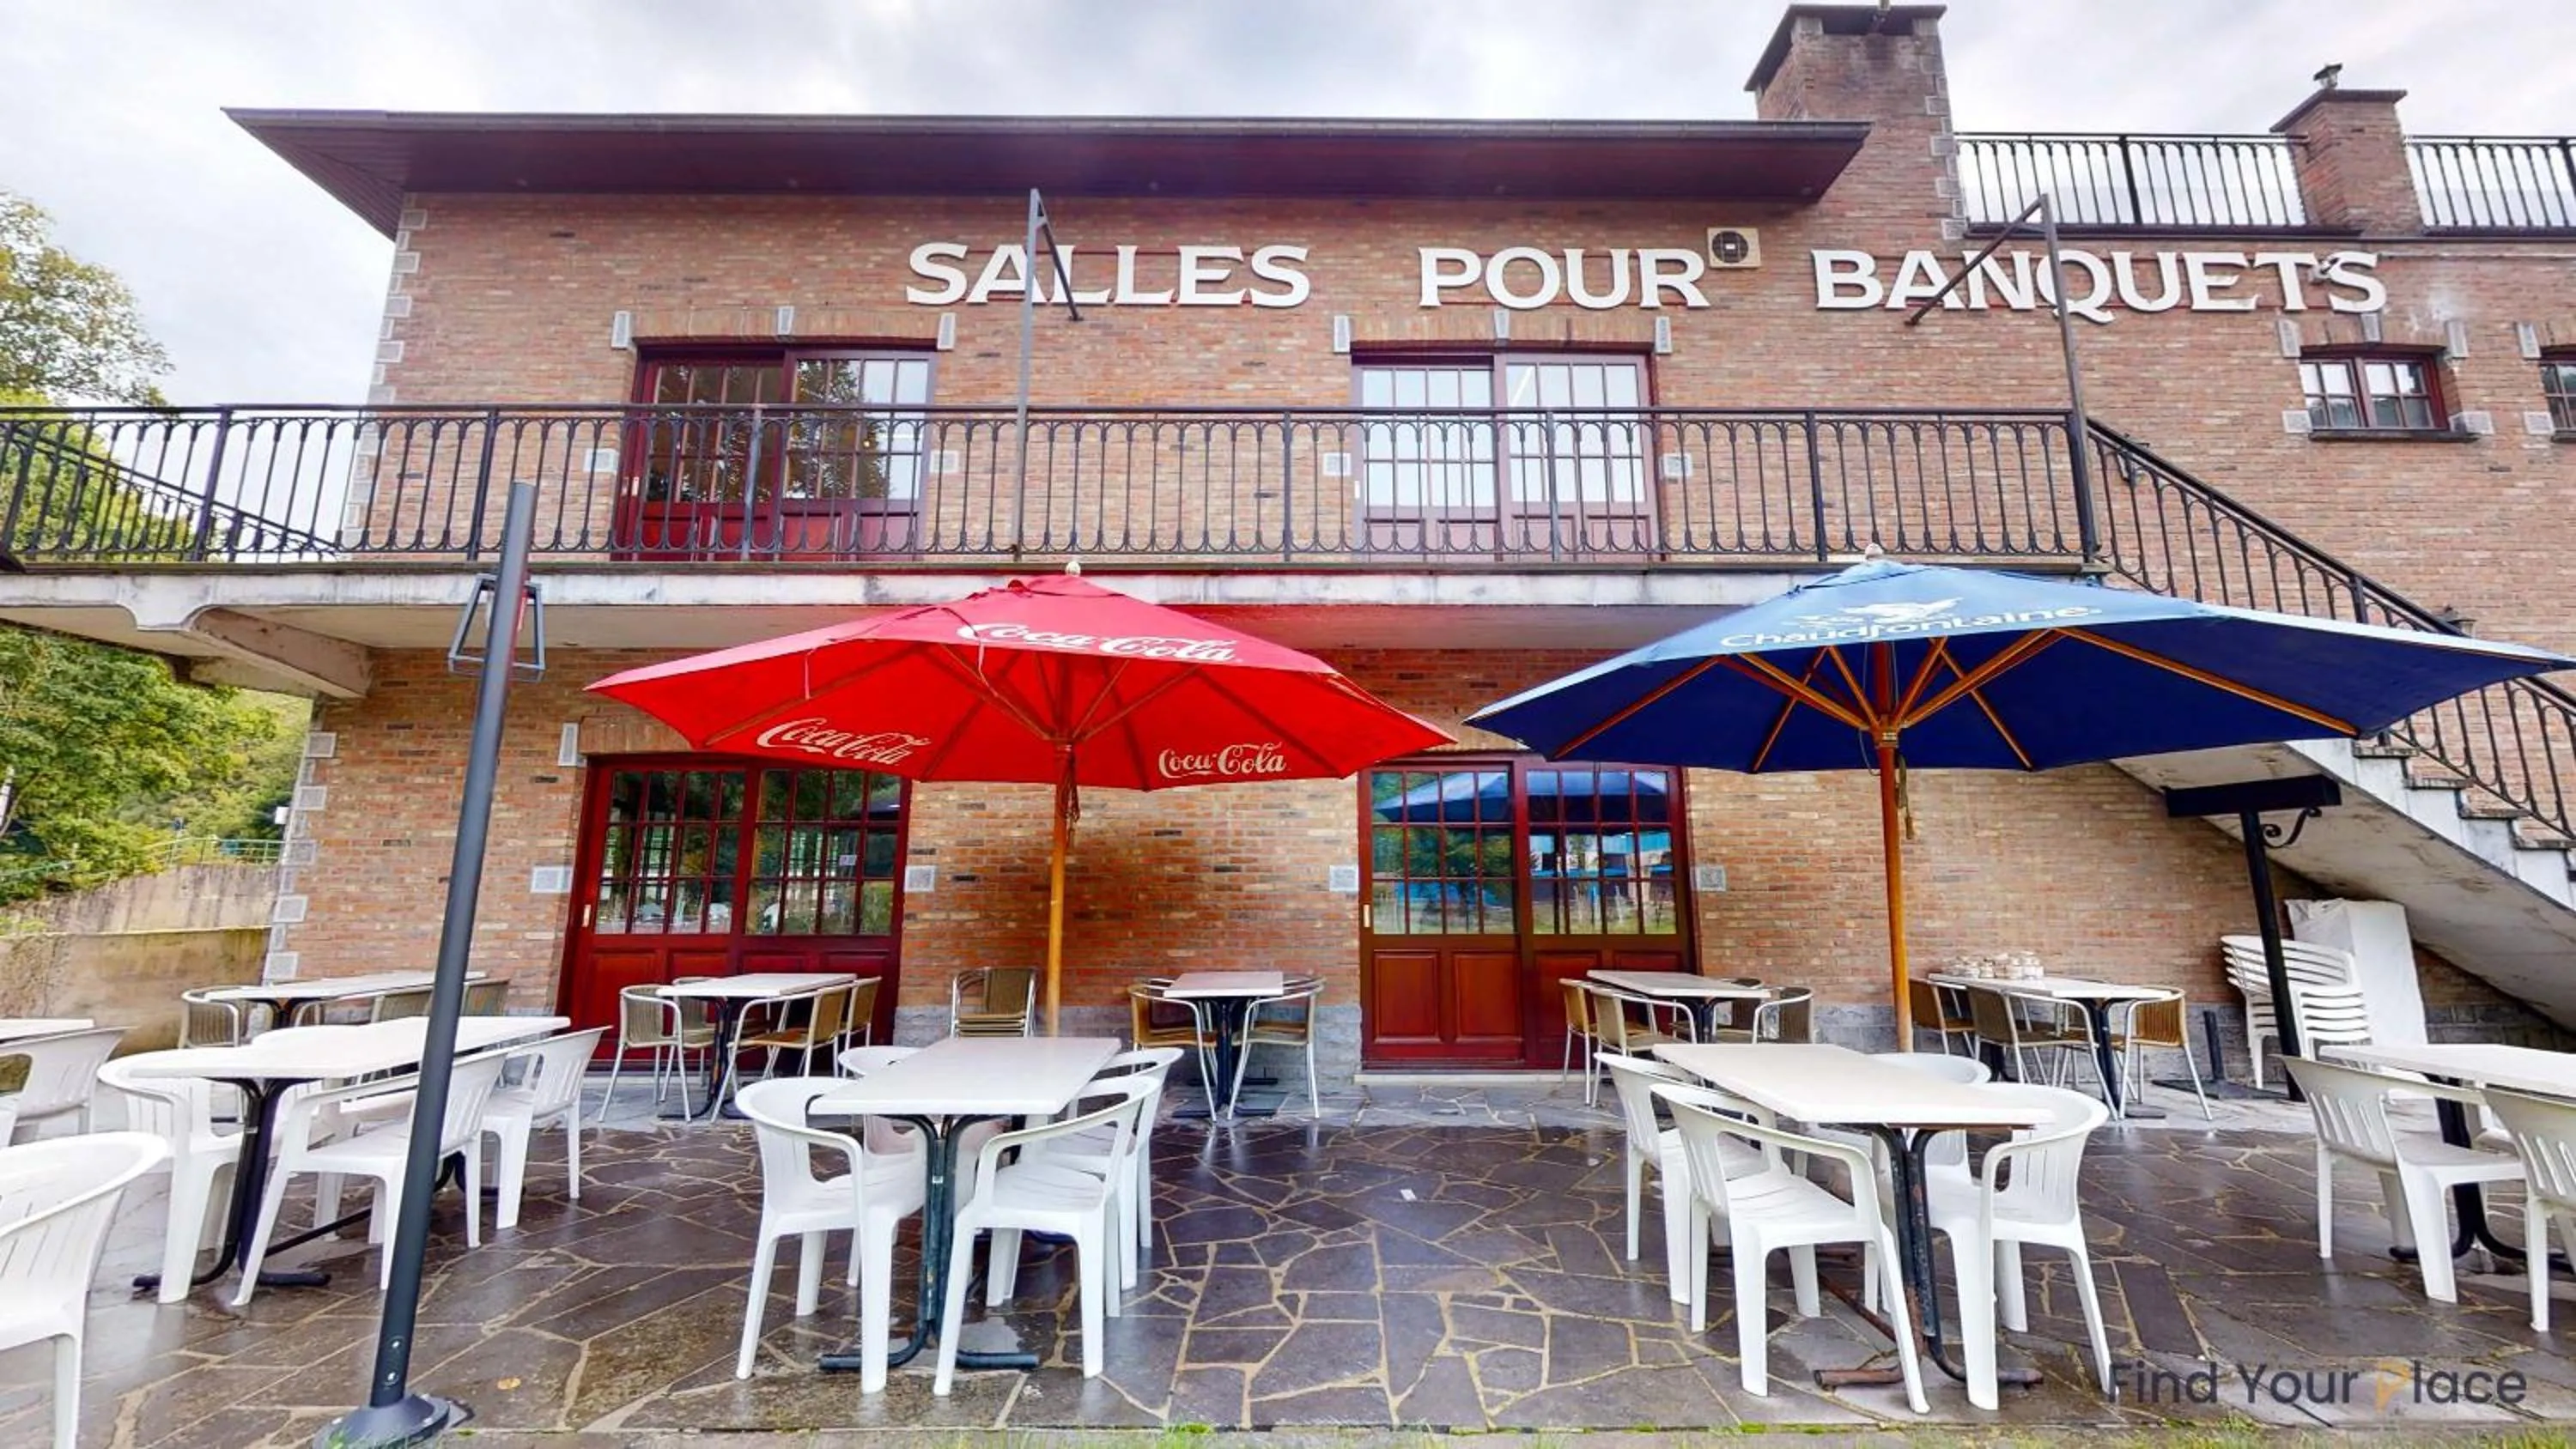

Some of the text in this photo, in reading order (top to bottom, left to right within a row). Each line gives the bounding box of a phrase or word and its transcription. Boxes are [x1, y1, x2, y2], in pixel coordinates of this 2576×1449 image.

[906, 243, 2387, 323] SALLES POUR BANQUETS
[1721, 604, 2095, 648] Chaudfontaine
